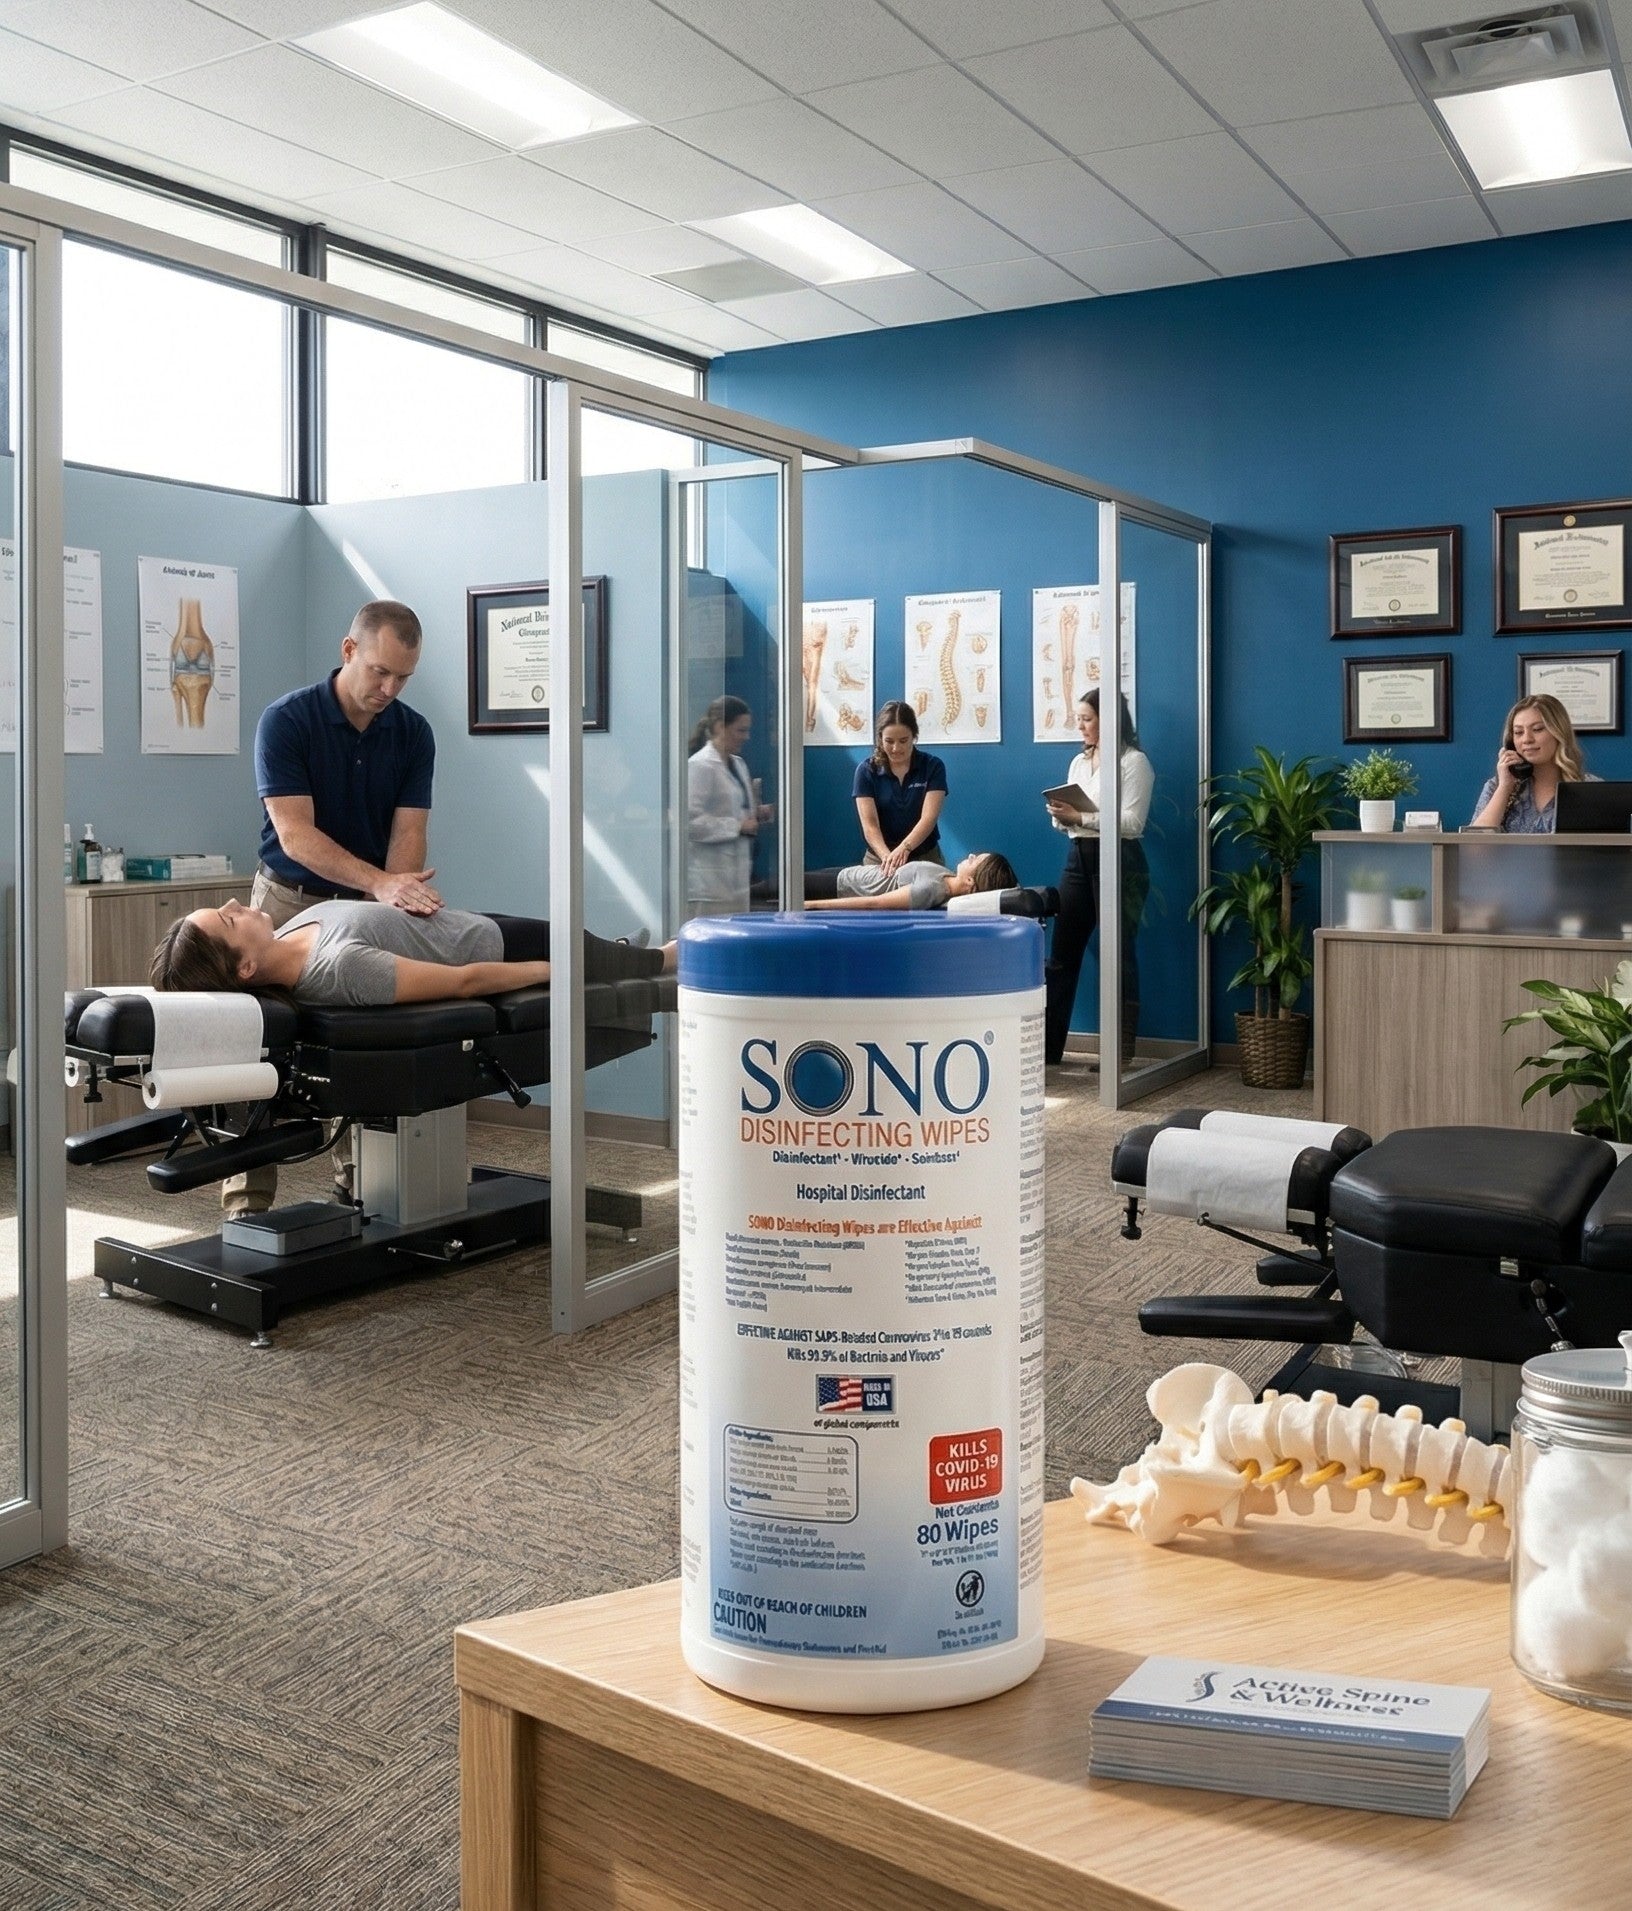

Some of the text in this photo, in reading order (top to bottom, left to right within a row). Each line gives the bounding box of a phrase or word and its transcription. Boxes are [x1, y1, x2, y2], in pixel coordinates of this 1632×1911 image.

[741, 1038, 990, 1117] SONO
[741, 1117, 990, 1148] DISINFECTING WIPES
[796, 1184, 926, 1203] Hospital Disinfectant
[890, 1350, 907, 1363] and
[866, 1393, 888, 1406] USA
[949, 1439, 988, 1458] KILLS
[935, 1453, 999, 1477] COVID-19
[945, 1473, 988, 1493] VIRUS
[935, 1506, 955, 1519] Net
[917, 1518, 999, 1545] 80 Wipes
[713, 1602, 767, 1634] CAUTION
[800, 1602, 813, 1615] OF
[814, 1603, 867, 1618] CHILDREN
[1232, 1677, 1431, 1707] Active Spine
